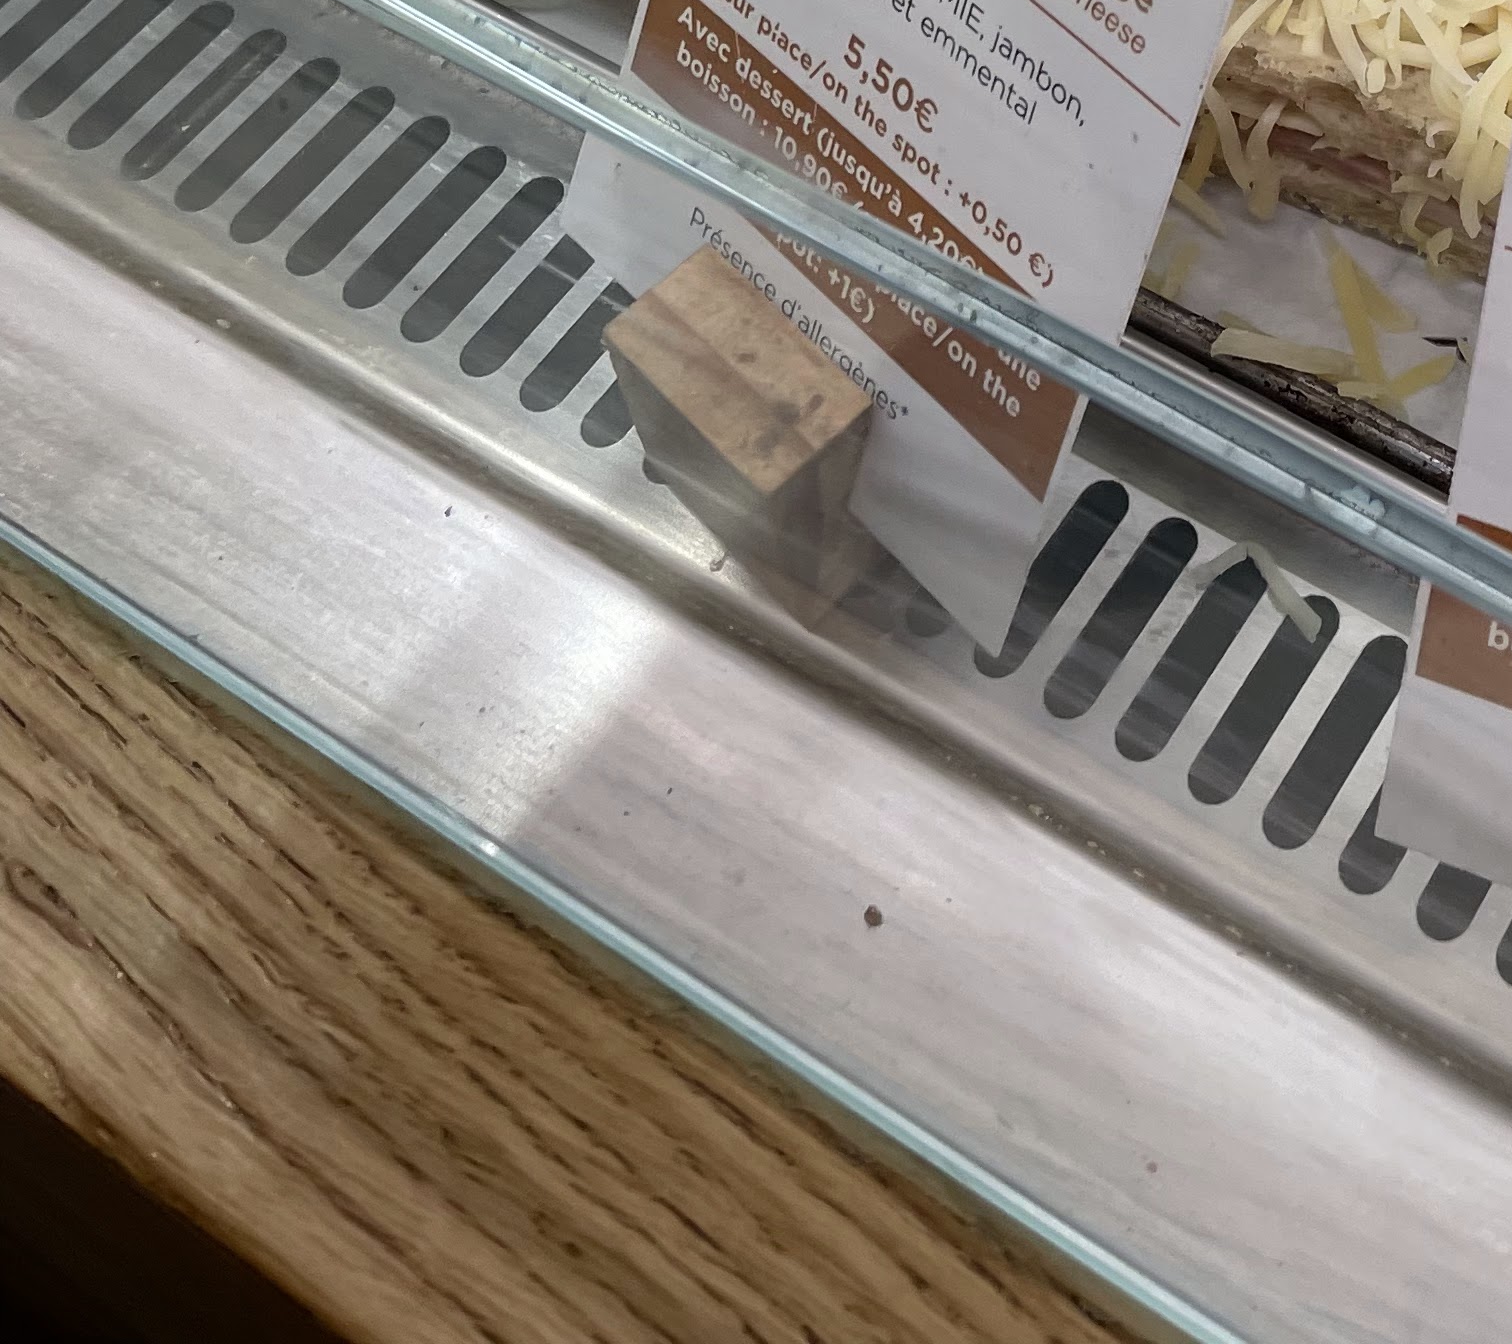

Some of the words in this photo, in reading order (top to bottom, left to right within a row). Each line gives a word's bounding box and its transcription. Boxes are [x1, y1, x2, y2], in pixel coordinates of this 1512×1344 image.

[677, 41, 756, 126] boisson
[677, 6, 731, 62] Avec
[735, 57, 812, 135] dessert
[817, 127, 903, 217] (jusqu'à
[844, 34, 938, 133] 5,50€
[921, 16, 1038, 125] emmental
[990, 25, 1085, 127] jambon,
[854, 95, 887, 137] the
[892, 134, 940, 185] spot
[944, 179, 952, 196] :
[960, 192, 1023, 256] +0,50
[1028, 252, 1054, 288] €)
[690, 207, 776, 301] Présence
[828, 268, 875, 323] +1€)
[983, 368, 1021, 417] the
